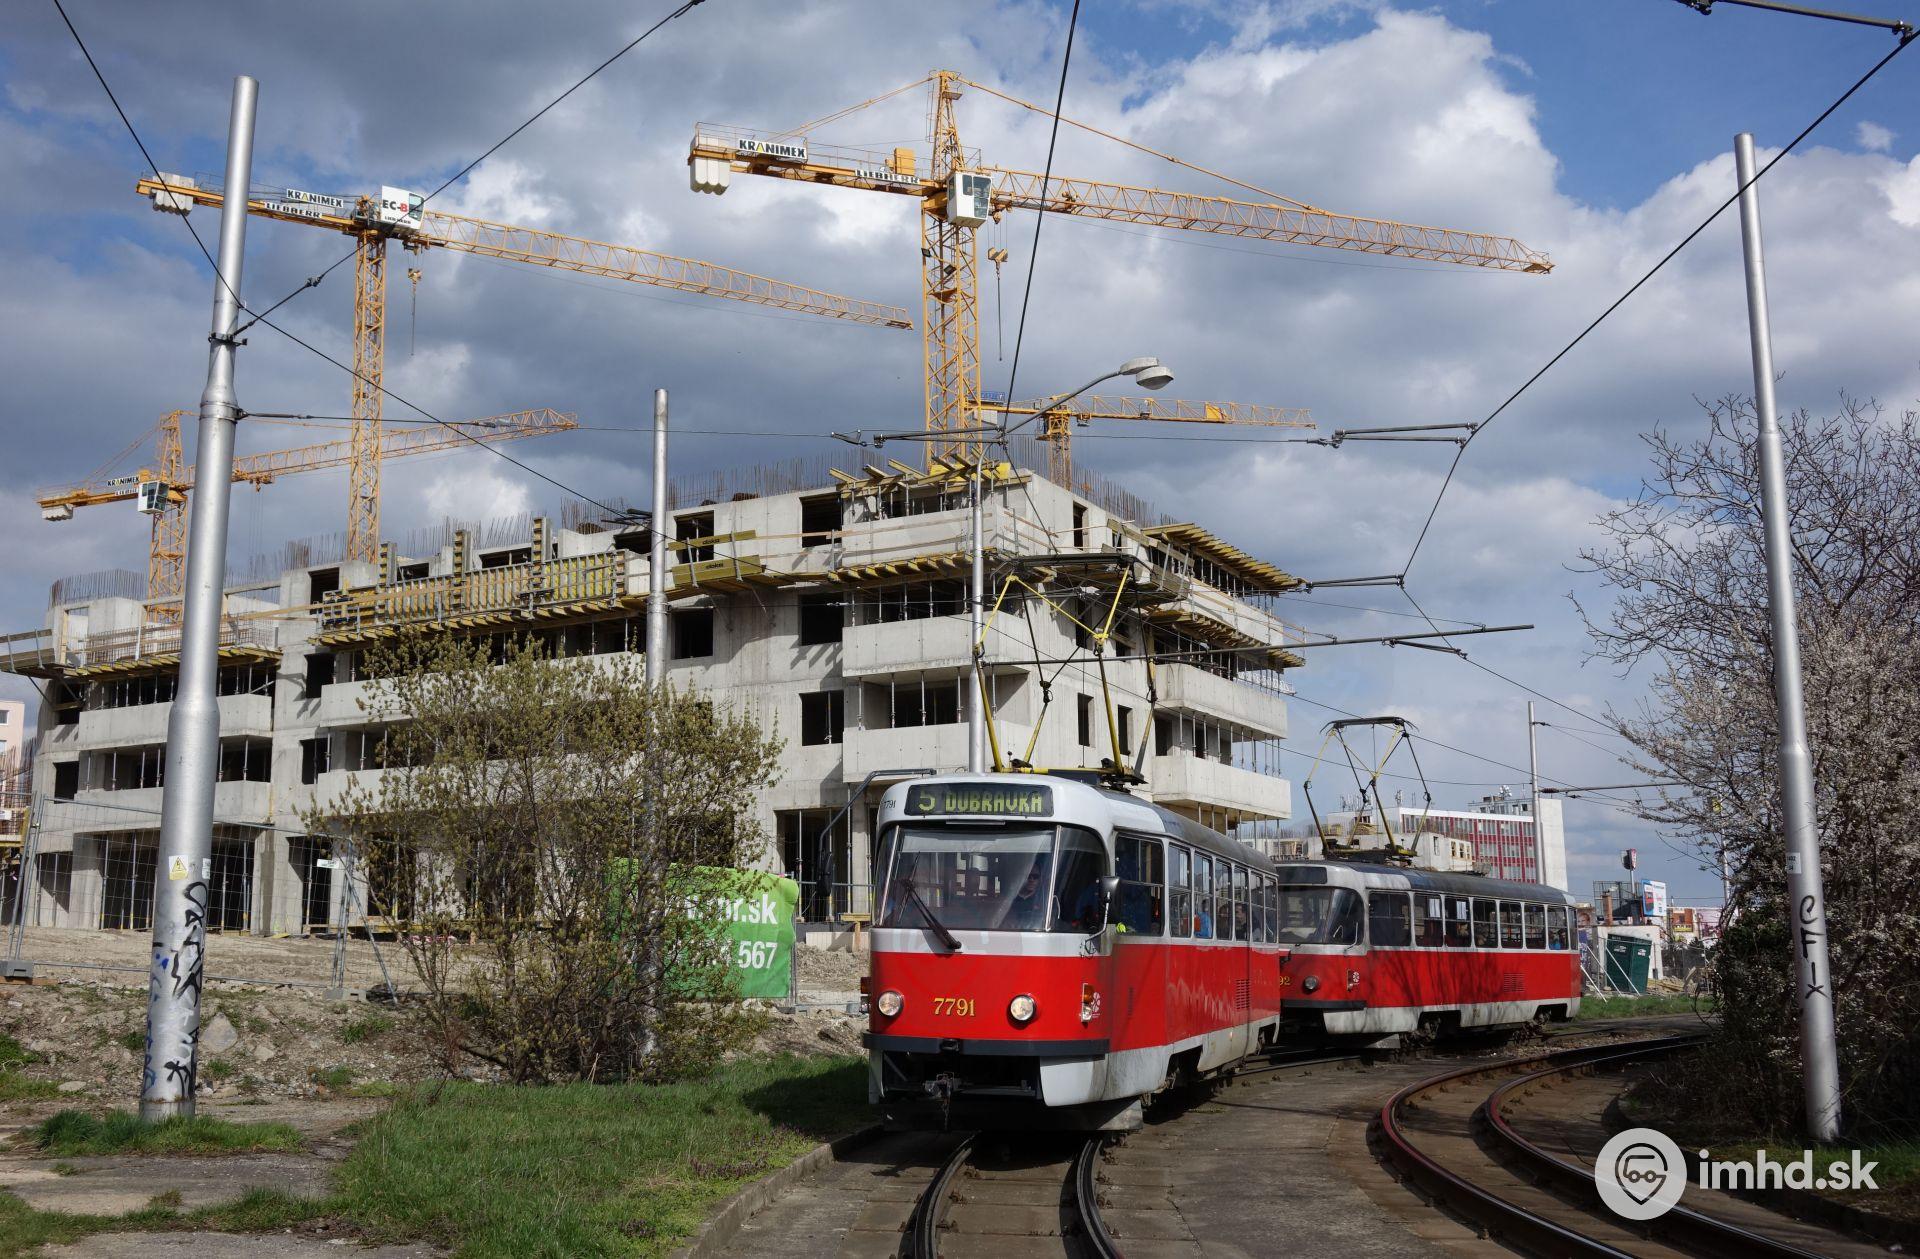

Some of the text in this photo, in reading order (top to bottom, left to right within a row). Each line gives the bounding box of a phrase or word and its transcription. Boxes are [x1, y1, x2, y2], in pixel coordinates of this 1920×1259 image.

[739, 139, 805, 157] KRANIMEX
[287, 189, 343, 208] KRANIMEX
[918, 790, 936, 811] 5
[934, 997, 976, 1017] 7791
